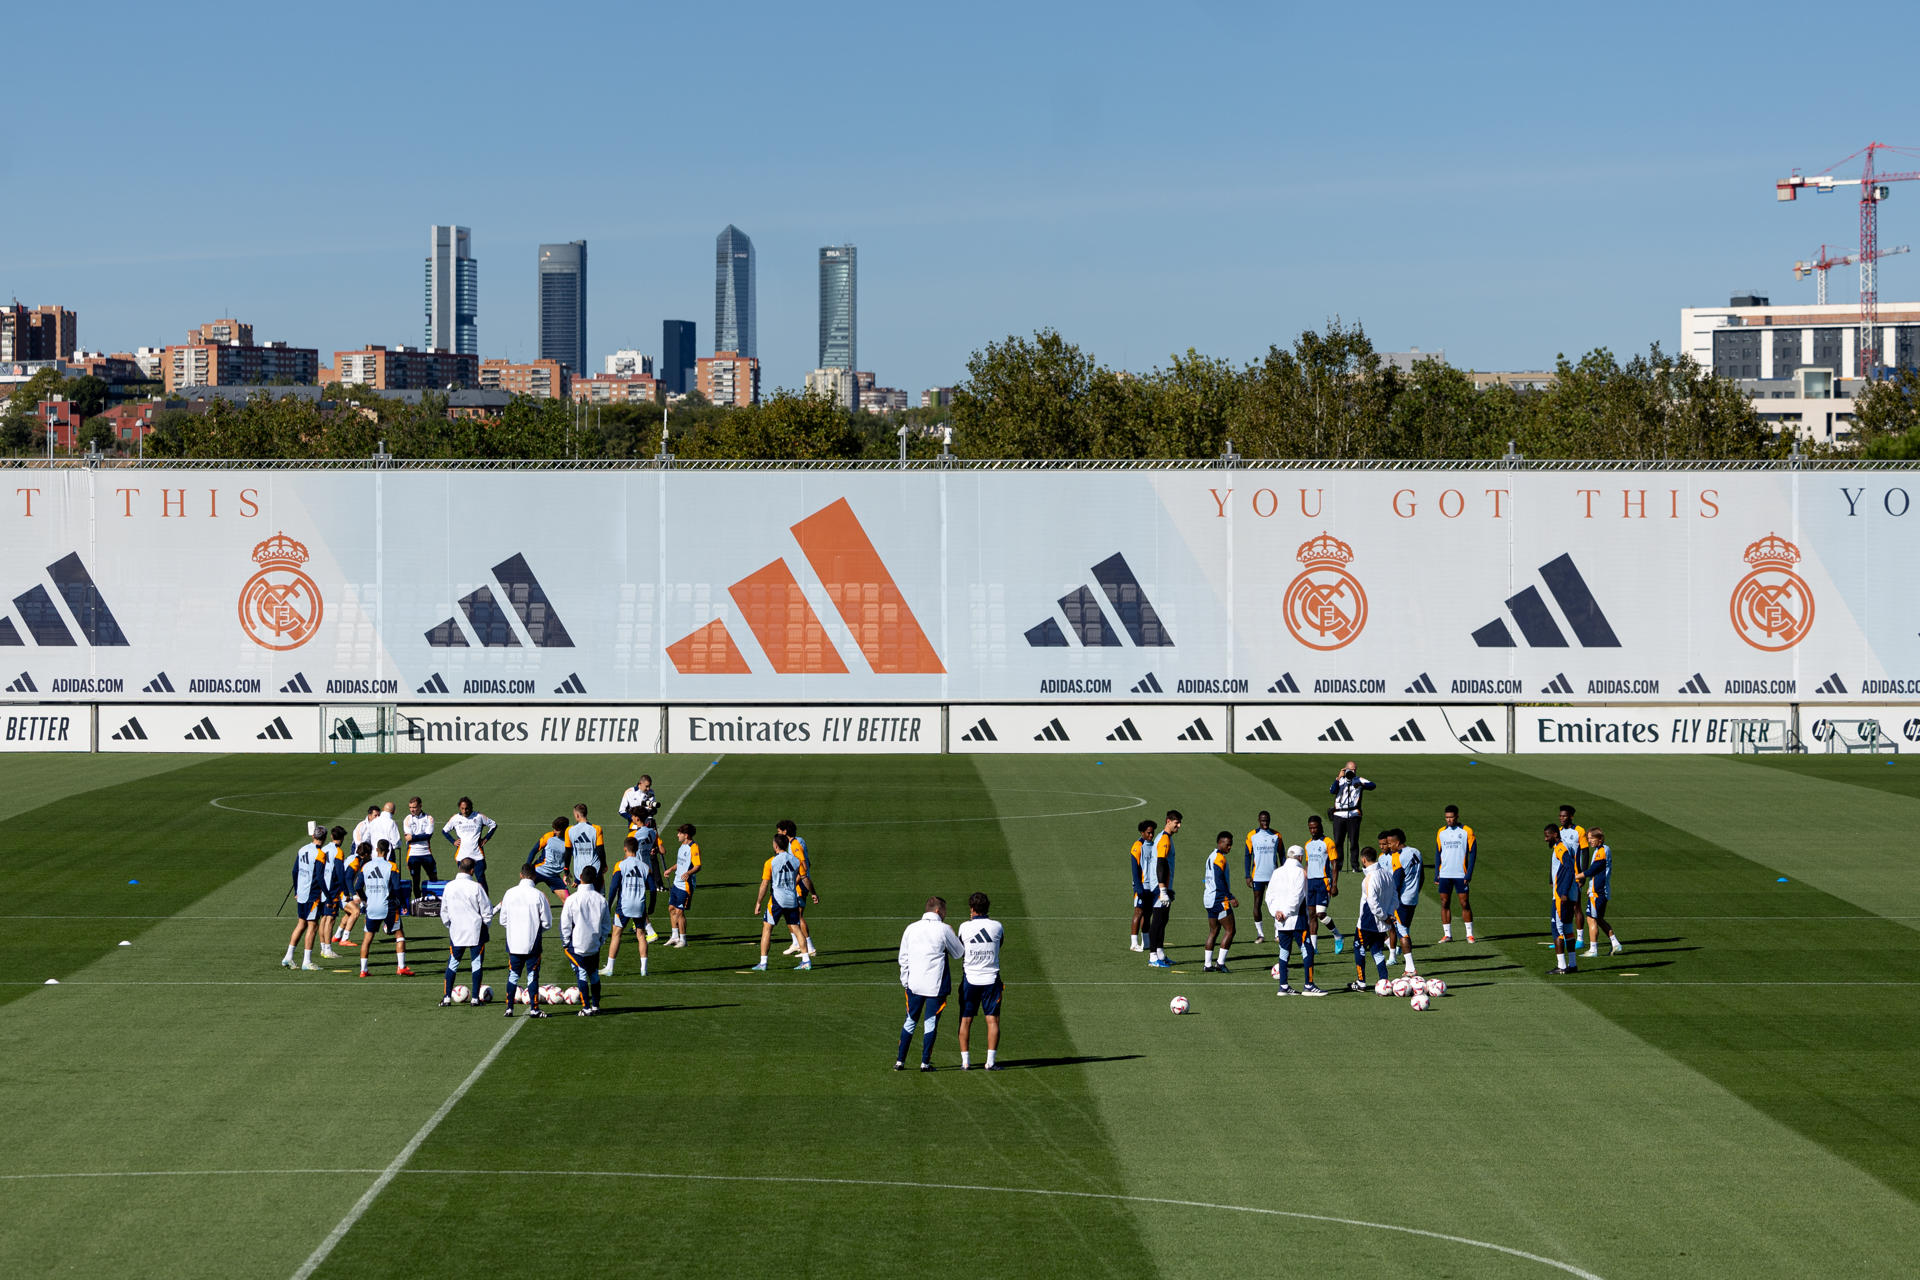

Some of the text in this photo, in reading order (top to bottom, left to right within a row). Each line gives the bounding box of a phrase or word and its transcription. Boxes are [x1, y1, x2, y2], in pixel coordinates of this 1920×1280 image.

[116, 488, 260, 518] THIS
[1207, 488, 1720, 519] YOU GOT THIS
[1840, 487, 1910, 517] YO
[52, 679, 123, 693] ADIDAS.COM
[189, 679, 260, 694] ADIDAS.COM
[326, 680, 397, 694] ADIDAS.COM
[463, 680, 535, 695] ADIDAS.COM
[1040, 679, 1111, 694] ADIDAS.COM
[1177, 679, 1248, 694] ADIDAS.COM
[1314, 679, 1385, 694] ADIDAS.COM
[1451, 679, 1522, 694] ADIDAS.COM
[1588, 680, 1659, 694] ADIDAS.COM
[1724, 680, 1796, 694] ADIDAS.COM
[5, 717, 70, 741] BETTER
[407, 716, 639, 742] Emirates FLY BETTER
[689, 716, 921, 742] Emirates FLY BETTER
[1537, 717, 1660, 743] Emirates
[1672, 718, 1702, 743] FLY
